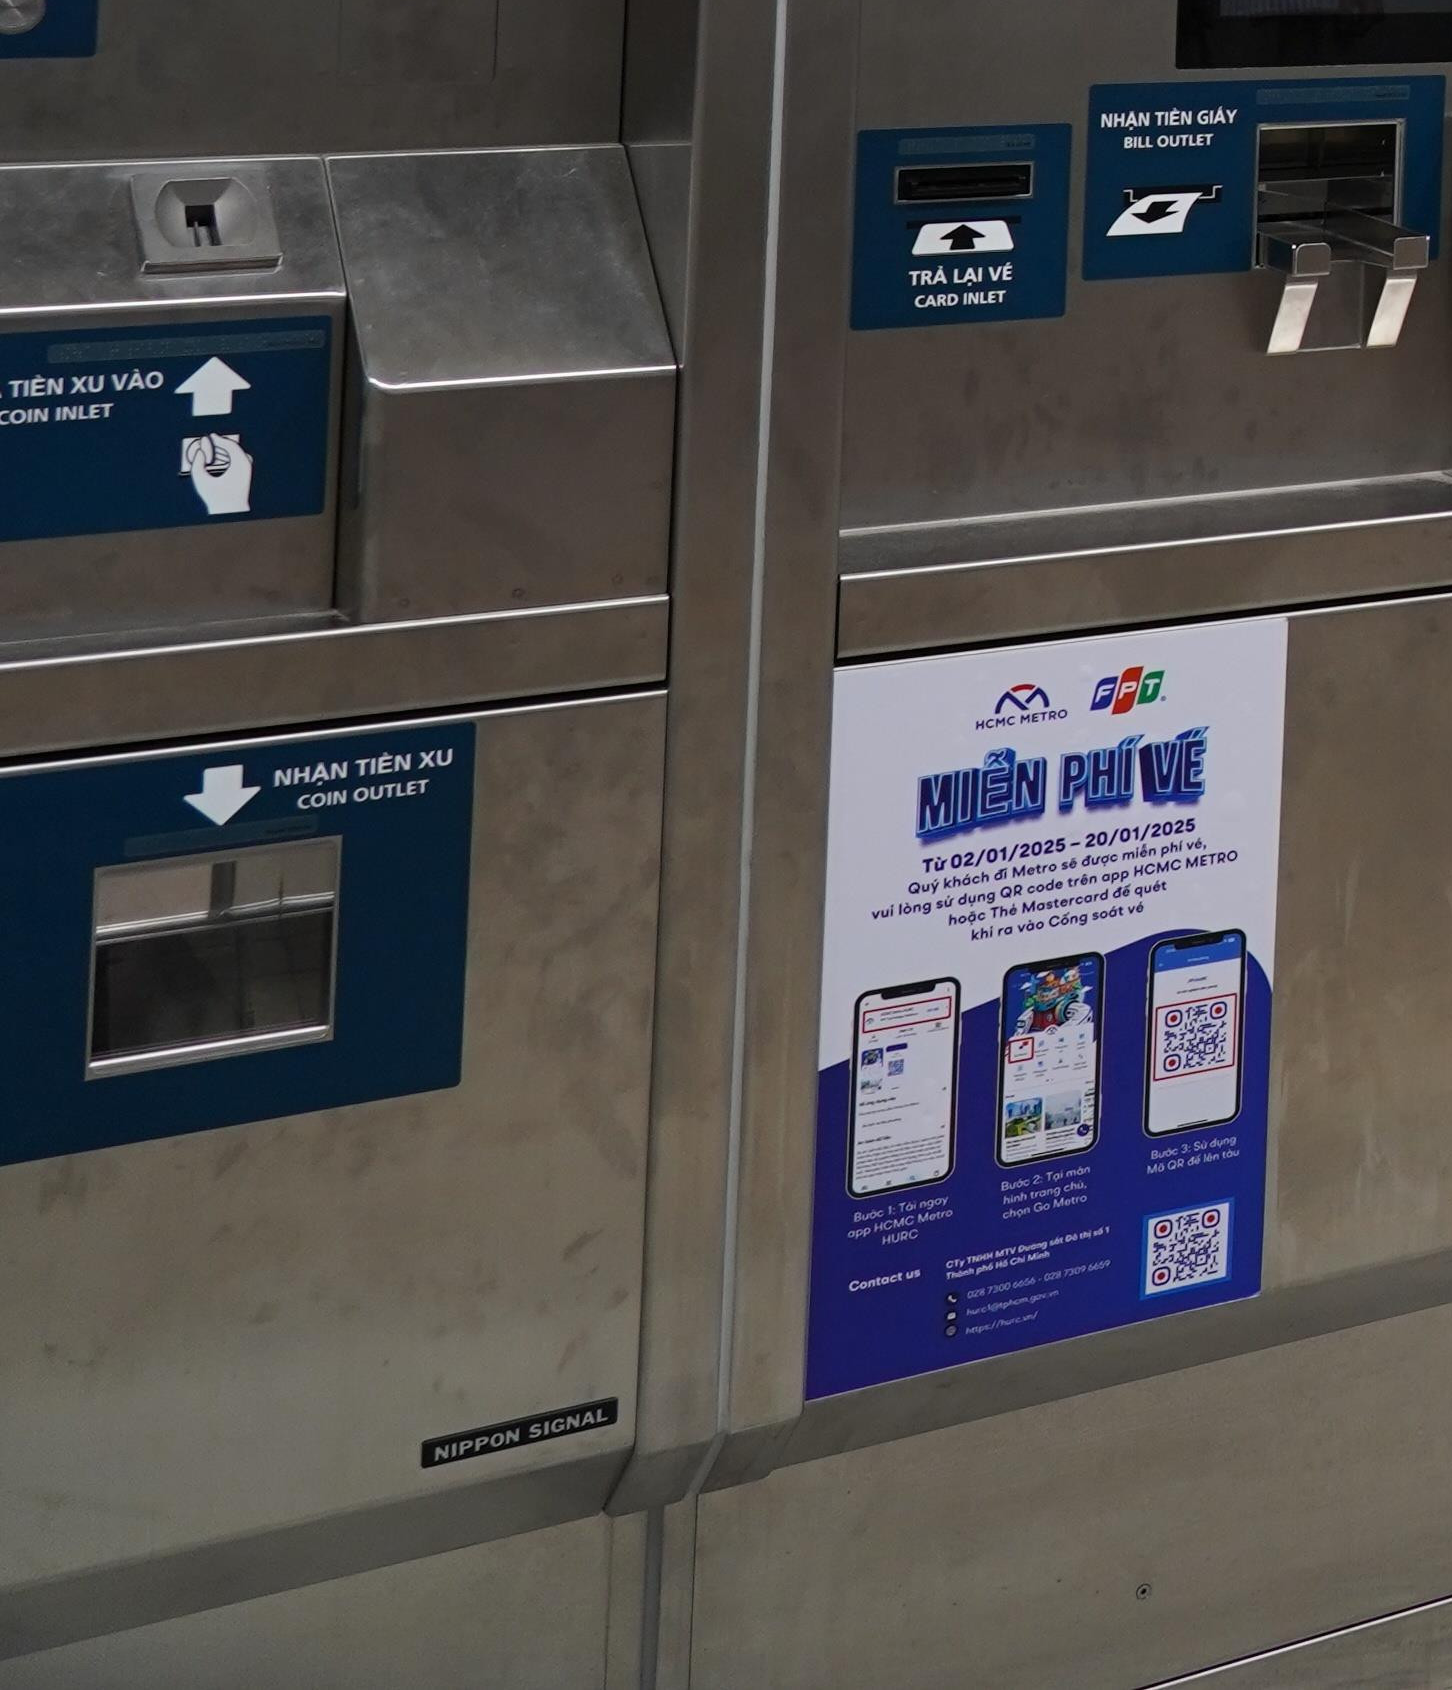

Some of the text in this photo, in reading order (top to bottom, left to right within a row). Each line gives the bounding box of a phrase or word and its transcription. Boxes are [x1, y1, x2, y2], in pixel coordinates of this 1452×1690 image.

[1124, 133, 1214, 149] BILL OUTLET
[908, 262, 1013, 286] TRẢ LẠI VÉ
[914, 290, 1006, 308] CARD INLET
[70, 375, 104, 394] XU
[111, 368, 164, 391] VÀO
[55, 403, 114, 421] INLET
[1090, 666, 1165, 715] FPT
[976, 709, 1068, 730] HCMC METRO
[418, 748, 453, 769] XU
[297, 779, 429, 809] COIN OUTLET
[916, 726, 1210, 842] MIỄN PHÍ VÉ
[922, 819, 1196, 873] Từ 02/01/2025 20/01/2025
[848, 1269, 921, 1292] Contact us
[434, 1408, 608, 1461] NIPPON SIGNAL
